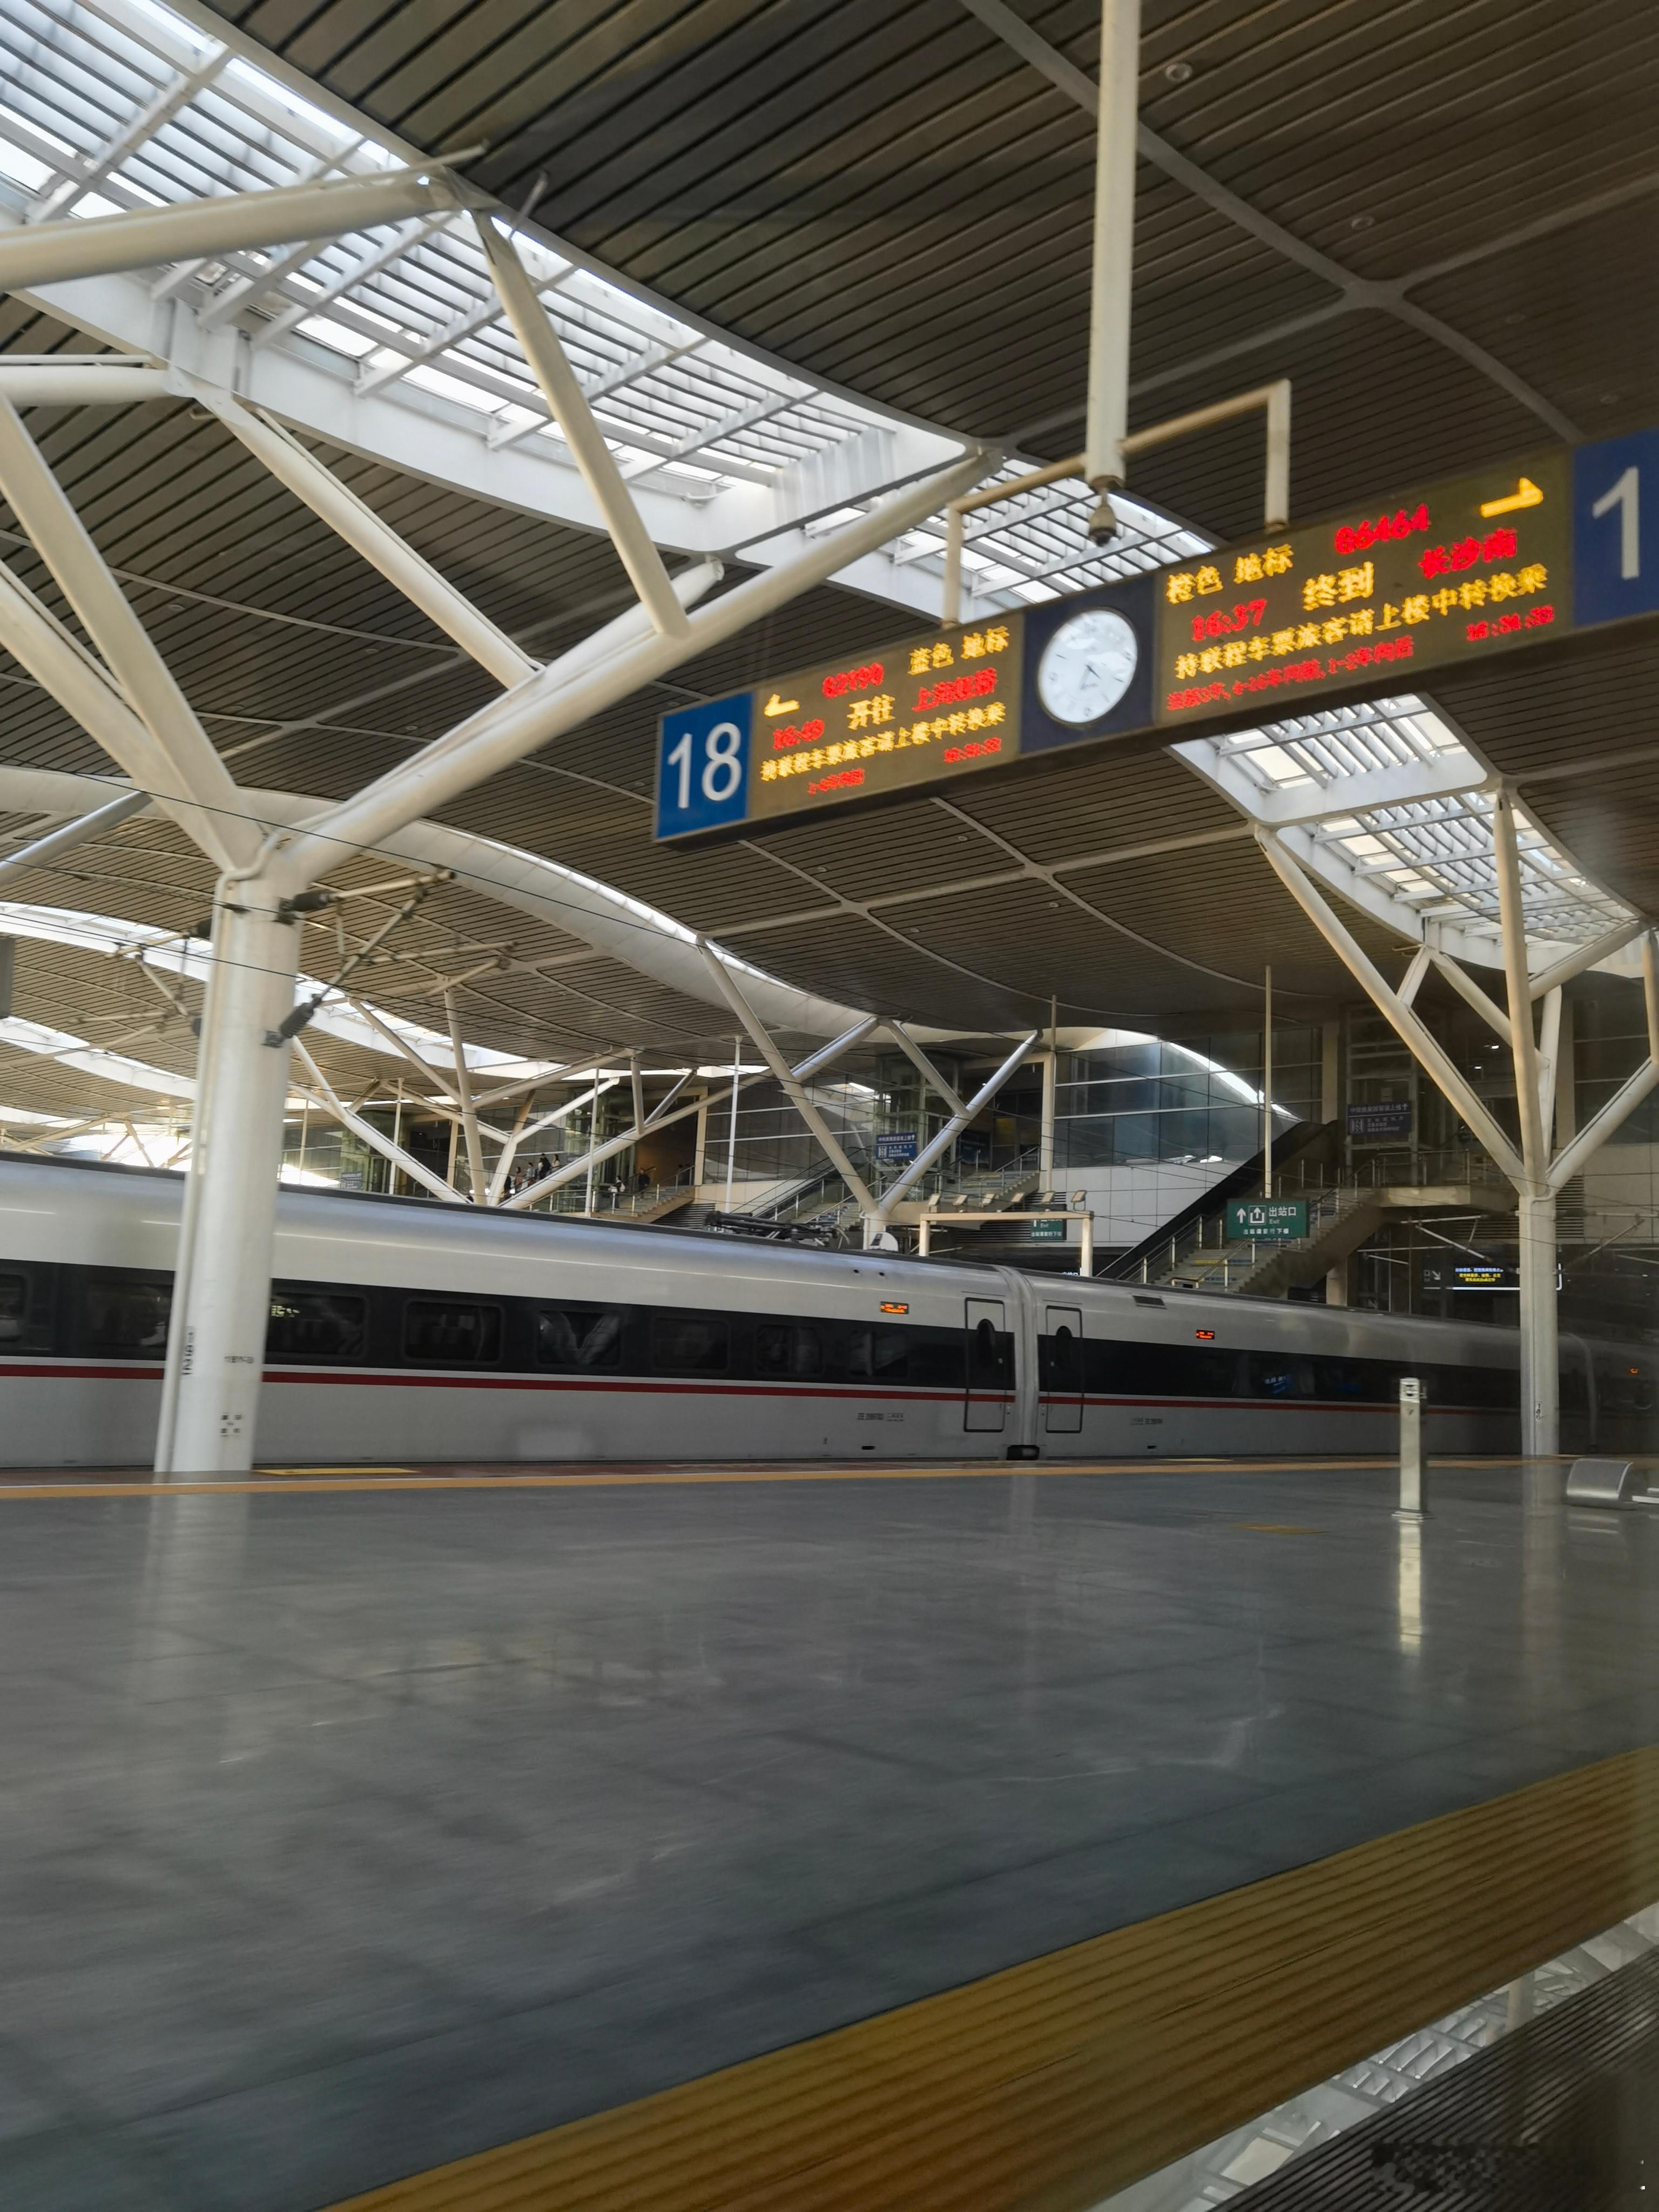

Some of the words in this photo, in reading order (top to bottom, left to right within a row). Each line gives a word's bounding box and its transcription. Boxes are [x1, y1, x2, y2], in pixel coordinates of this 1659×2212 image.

[1165, 565, 1224, 604] 棕色
[1233, 544, 1294, 584] 地标
[1418, 527, 1518, 579] 长沙南
[1302, 561, 1374, 611] 终到
[961, 626, 1010, 659] 地标
[1192, 598, 1267, 642] 16:37
[846, 694, 896, 730] 开往
[667, 722, 741, 809] 18
[1269, 1206, 1297, 1217] 出站口
